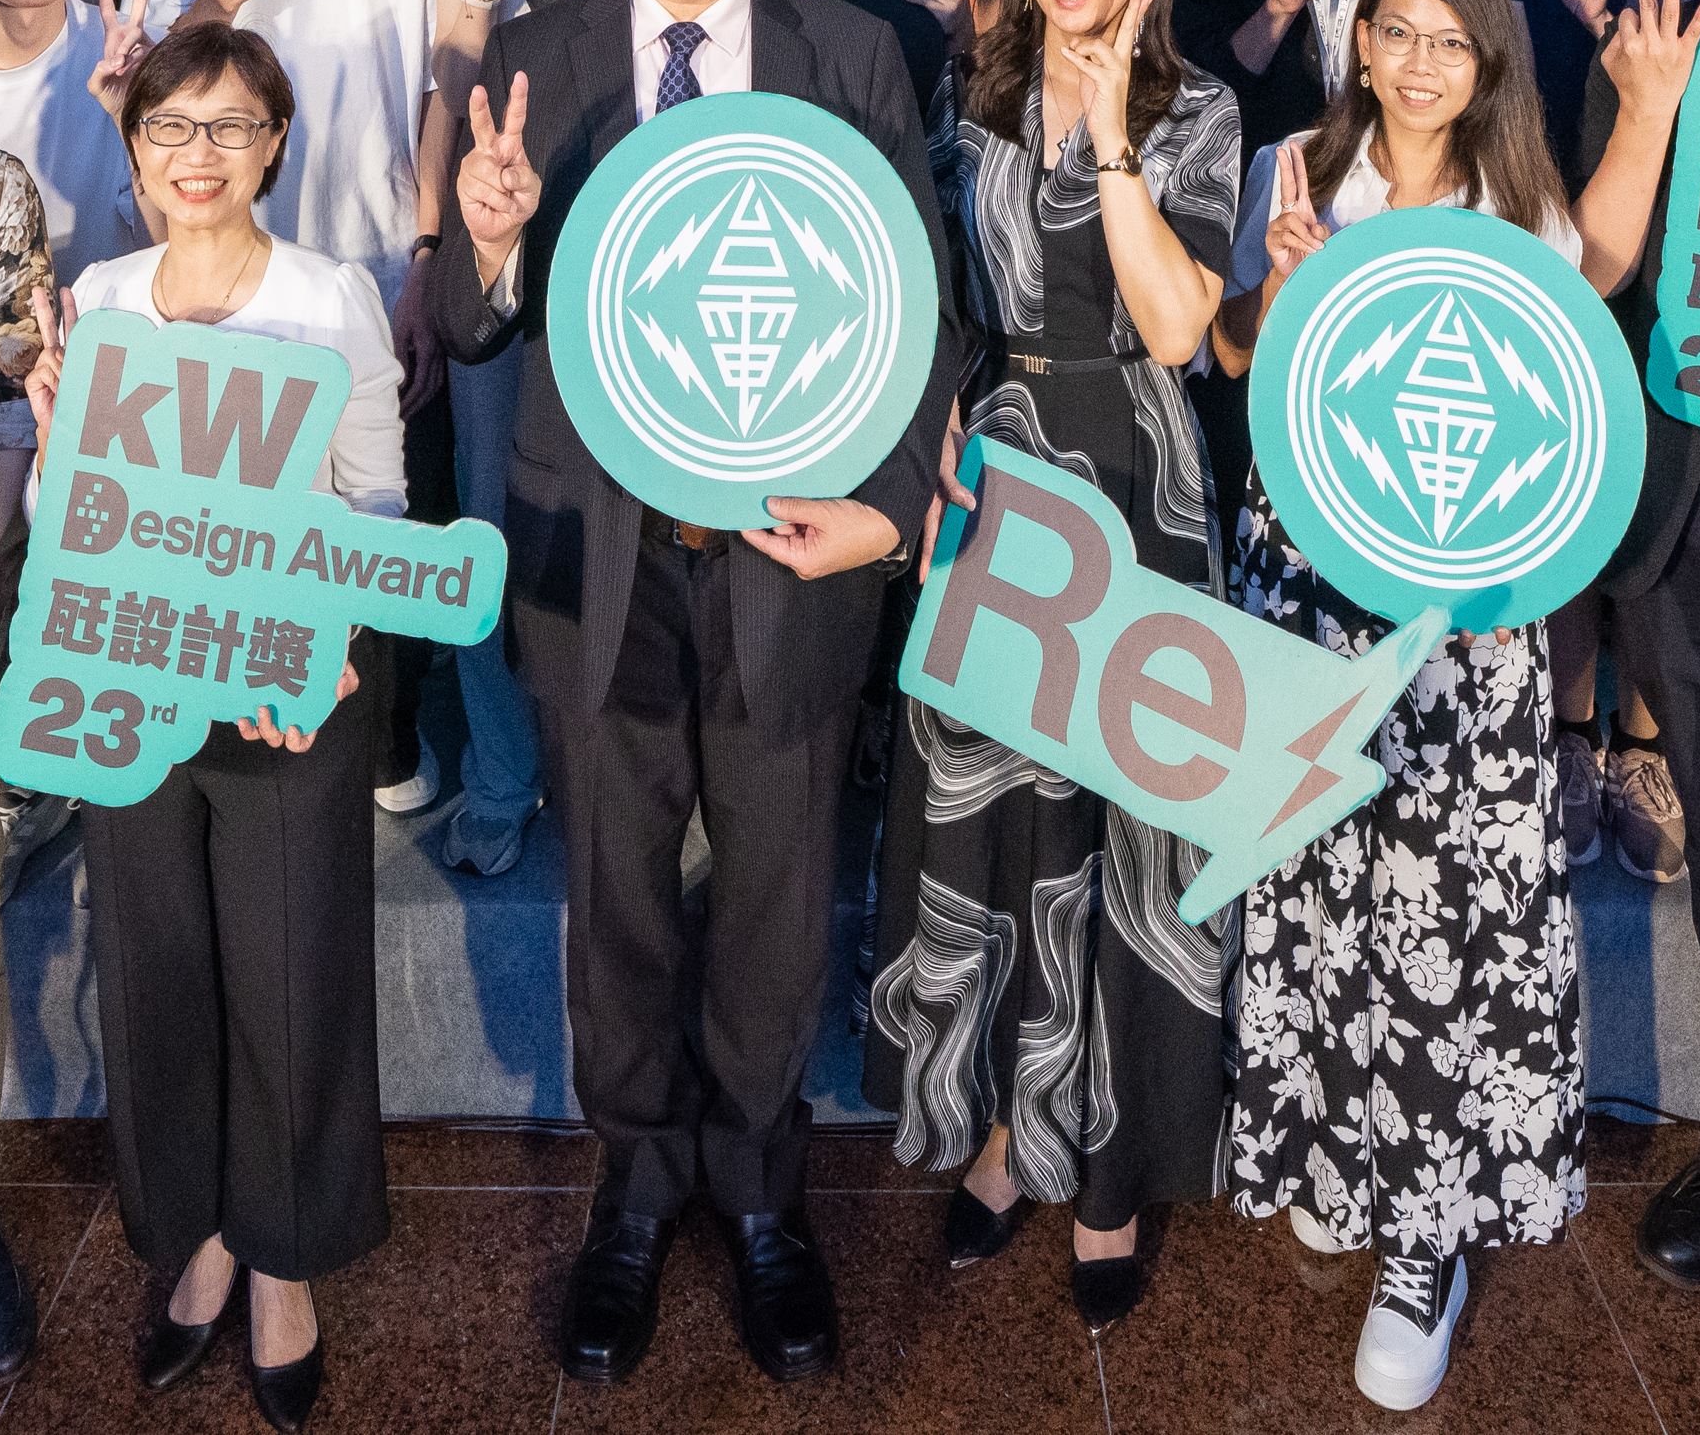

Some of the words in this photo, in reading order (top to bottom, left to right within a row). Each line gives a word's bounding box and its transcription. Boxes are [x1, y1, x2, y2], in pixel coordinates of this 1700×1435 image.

[77, 343, 319, 489] kW
[60, 470, 276, 577] Design
[286, 528, 474, 608] Award
[921, 466, 1247, 801] Re
